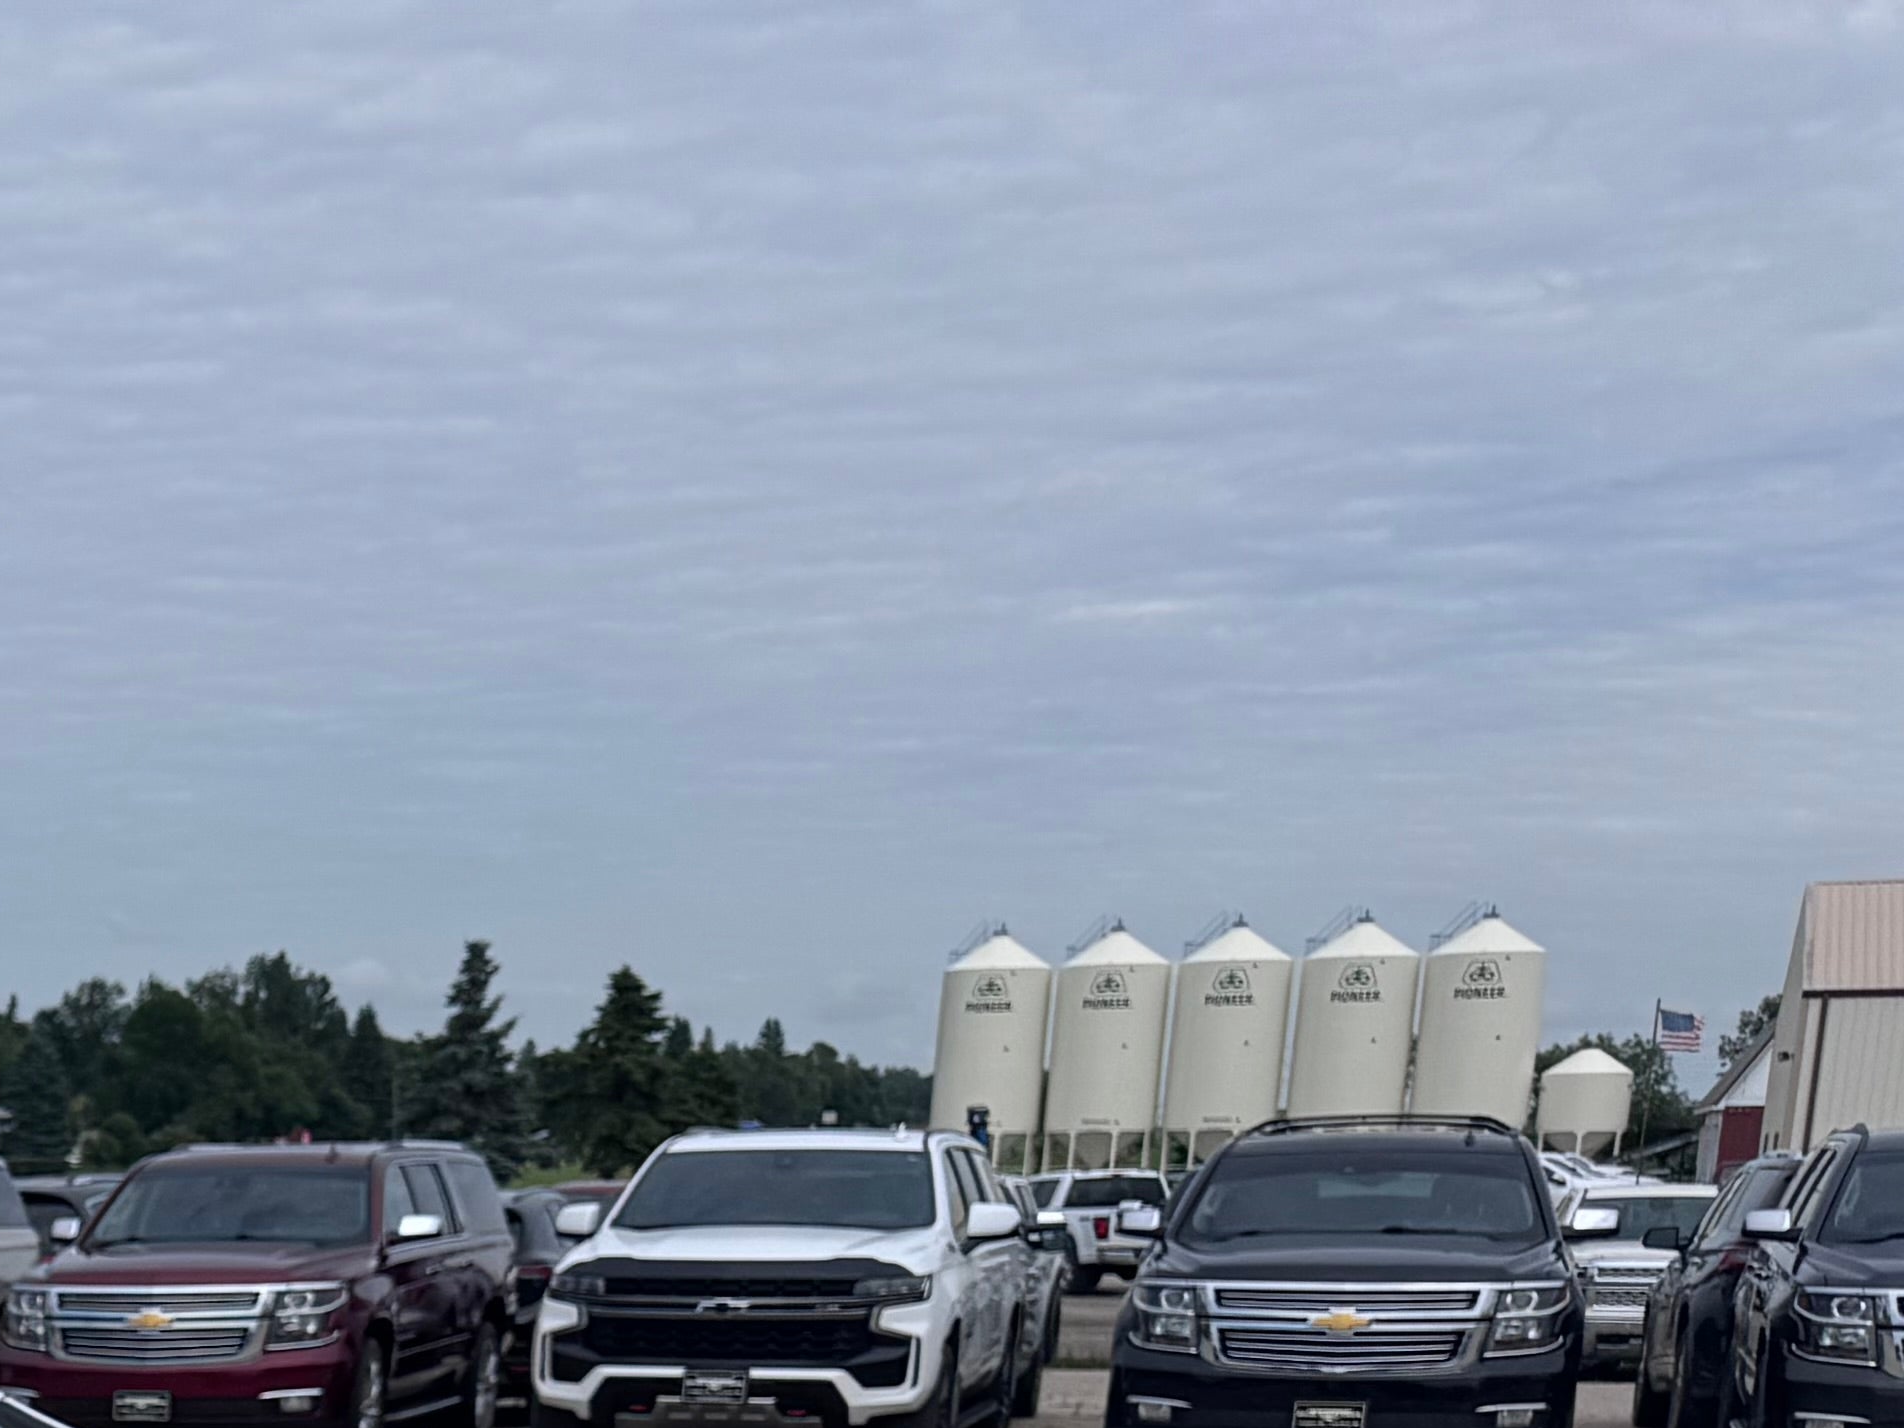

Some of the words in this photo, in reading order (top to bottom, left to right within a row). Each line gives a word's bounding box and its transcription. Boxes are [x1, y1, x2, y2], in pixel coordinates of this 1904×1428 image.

[1330, 990, 1382, 1004] PIONEER
[1454, 986, 1506, 1000] PIONEER
[965, 1001, 1012, 1013] PIONEER
[1082, 998, 1130, 1010] PIONEER
[1204, 994, 1254, 1007] PIONEER
